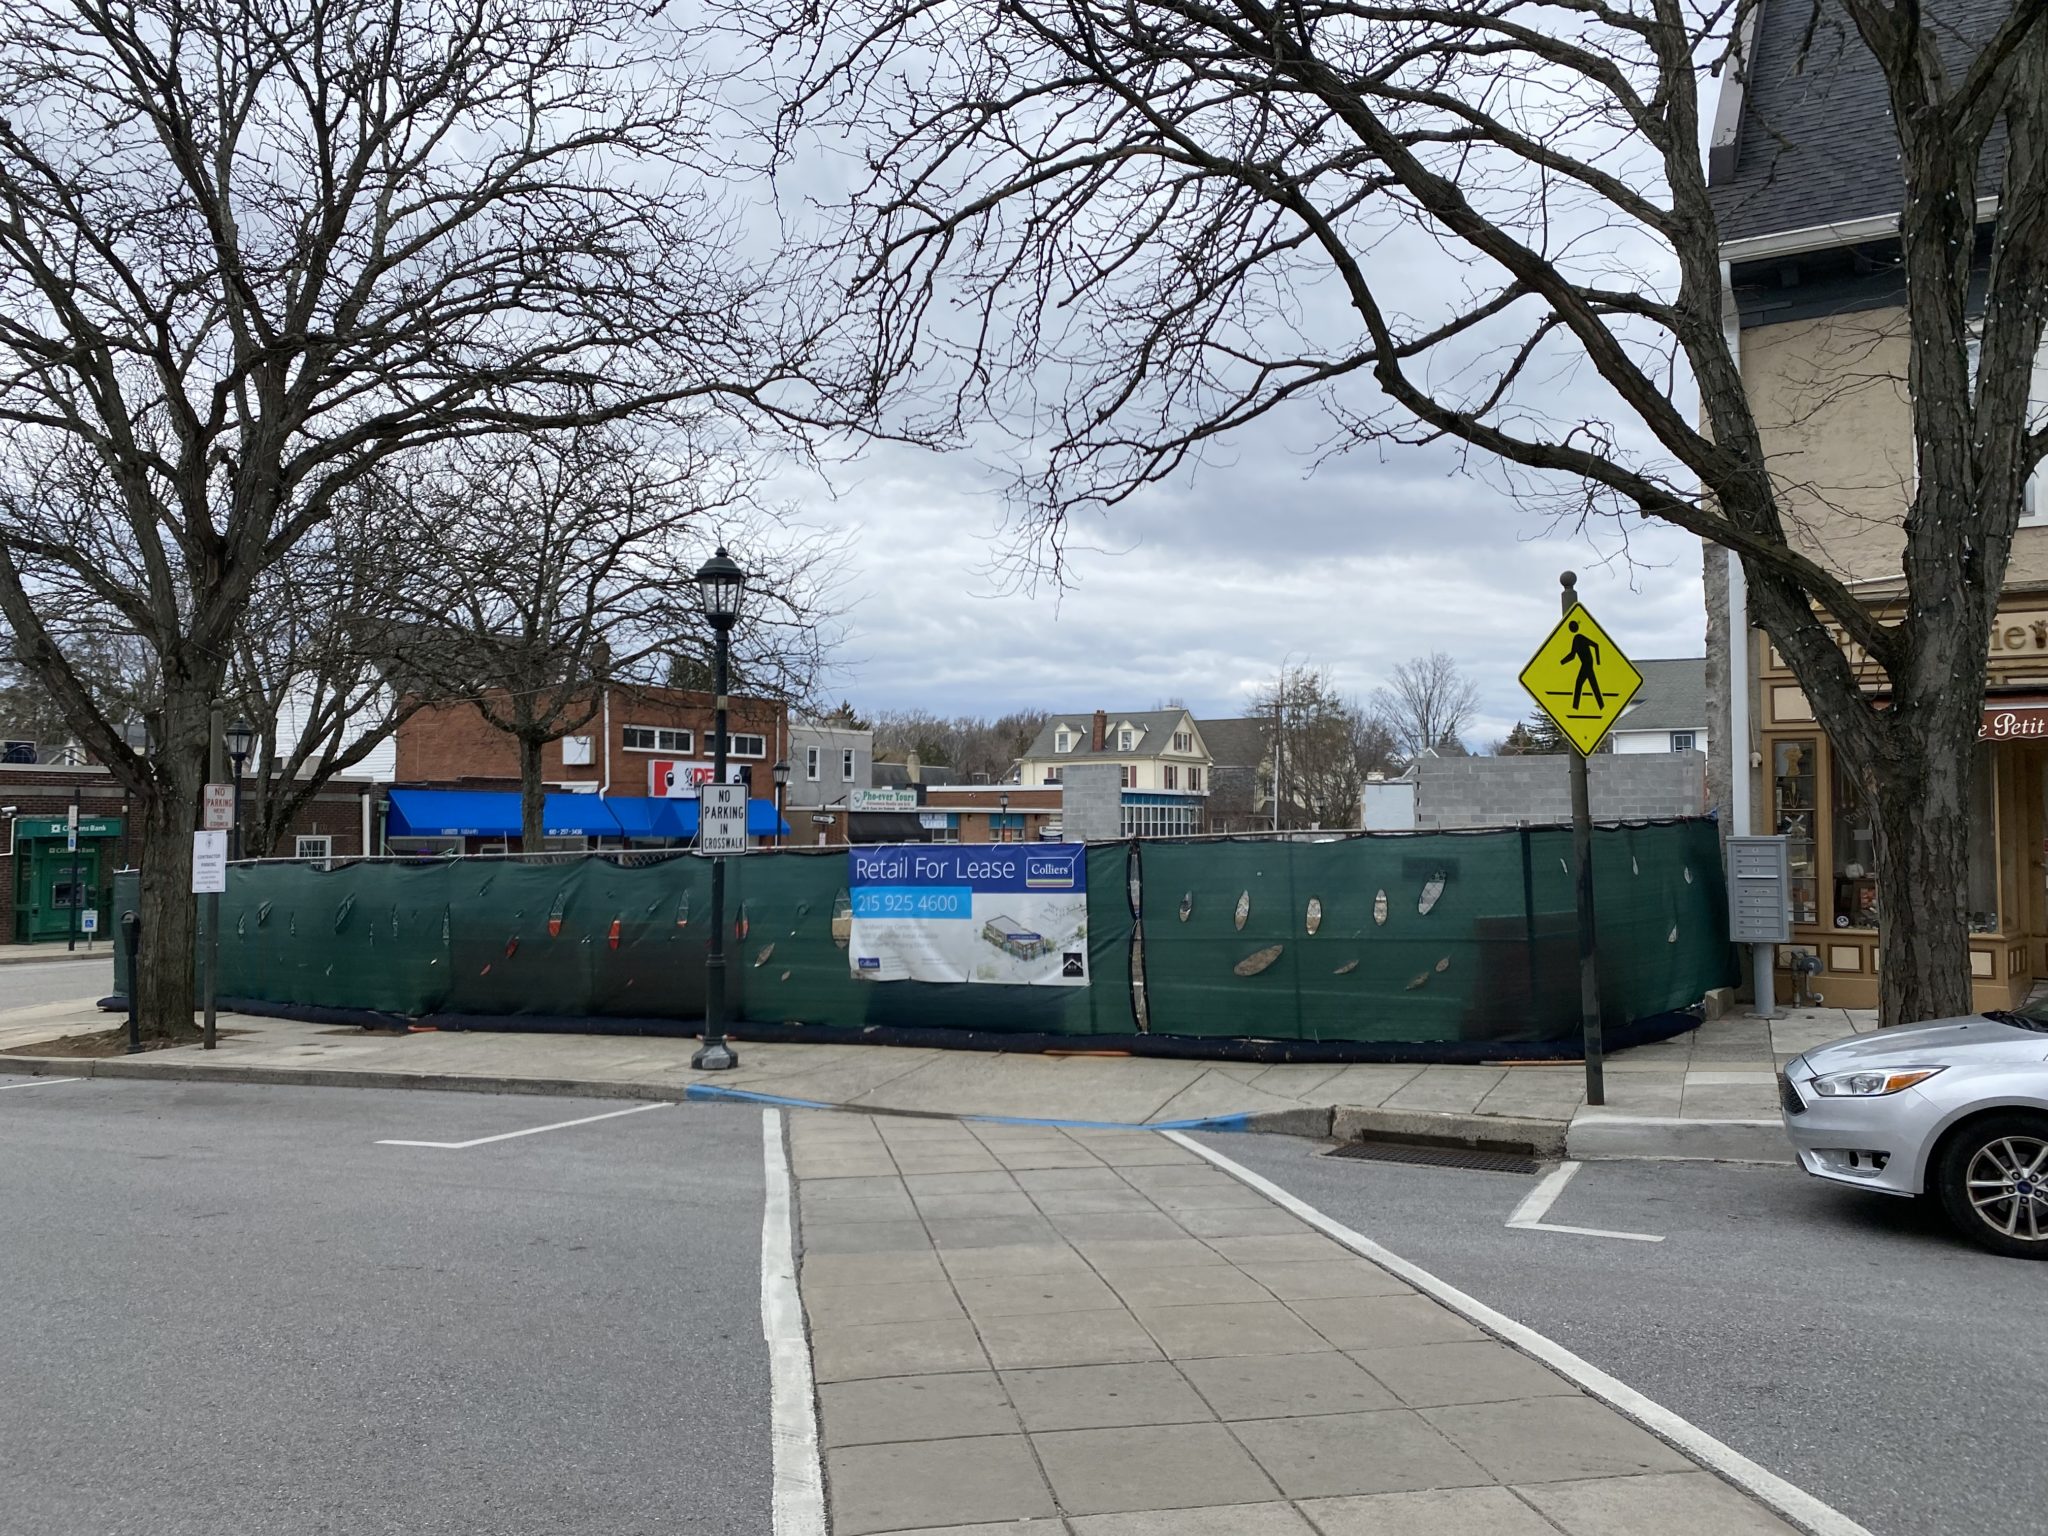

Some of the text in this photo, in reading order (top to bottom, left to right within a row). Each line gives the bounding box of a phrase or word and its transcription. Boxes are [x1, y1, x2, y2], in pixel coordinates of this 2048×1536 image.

[1994, 712, 2044, 737] Petit
[214, 787, 225, 796] NO
[718, 789, 731, 803] NO
[895, 791, 914, 802] Yours
[207, 799, 233, 807] PARKING
[704, 805, 744, 820] PARKING
[90, 824, 106, 832] Bank
[720, 823, 729, 835] IN
[704, 837, 744, 850] CROSSWALK
[856, 857, 1016, 880] Retail For Lease
[1031, 863, 1069, 876] Colliers
[858, 895, 958, 913] 215 925 4600
